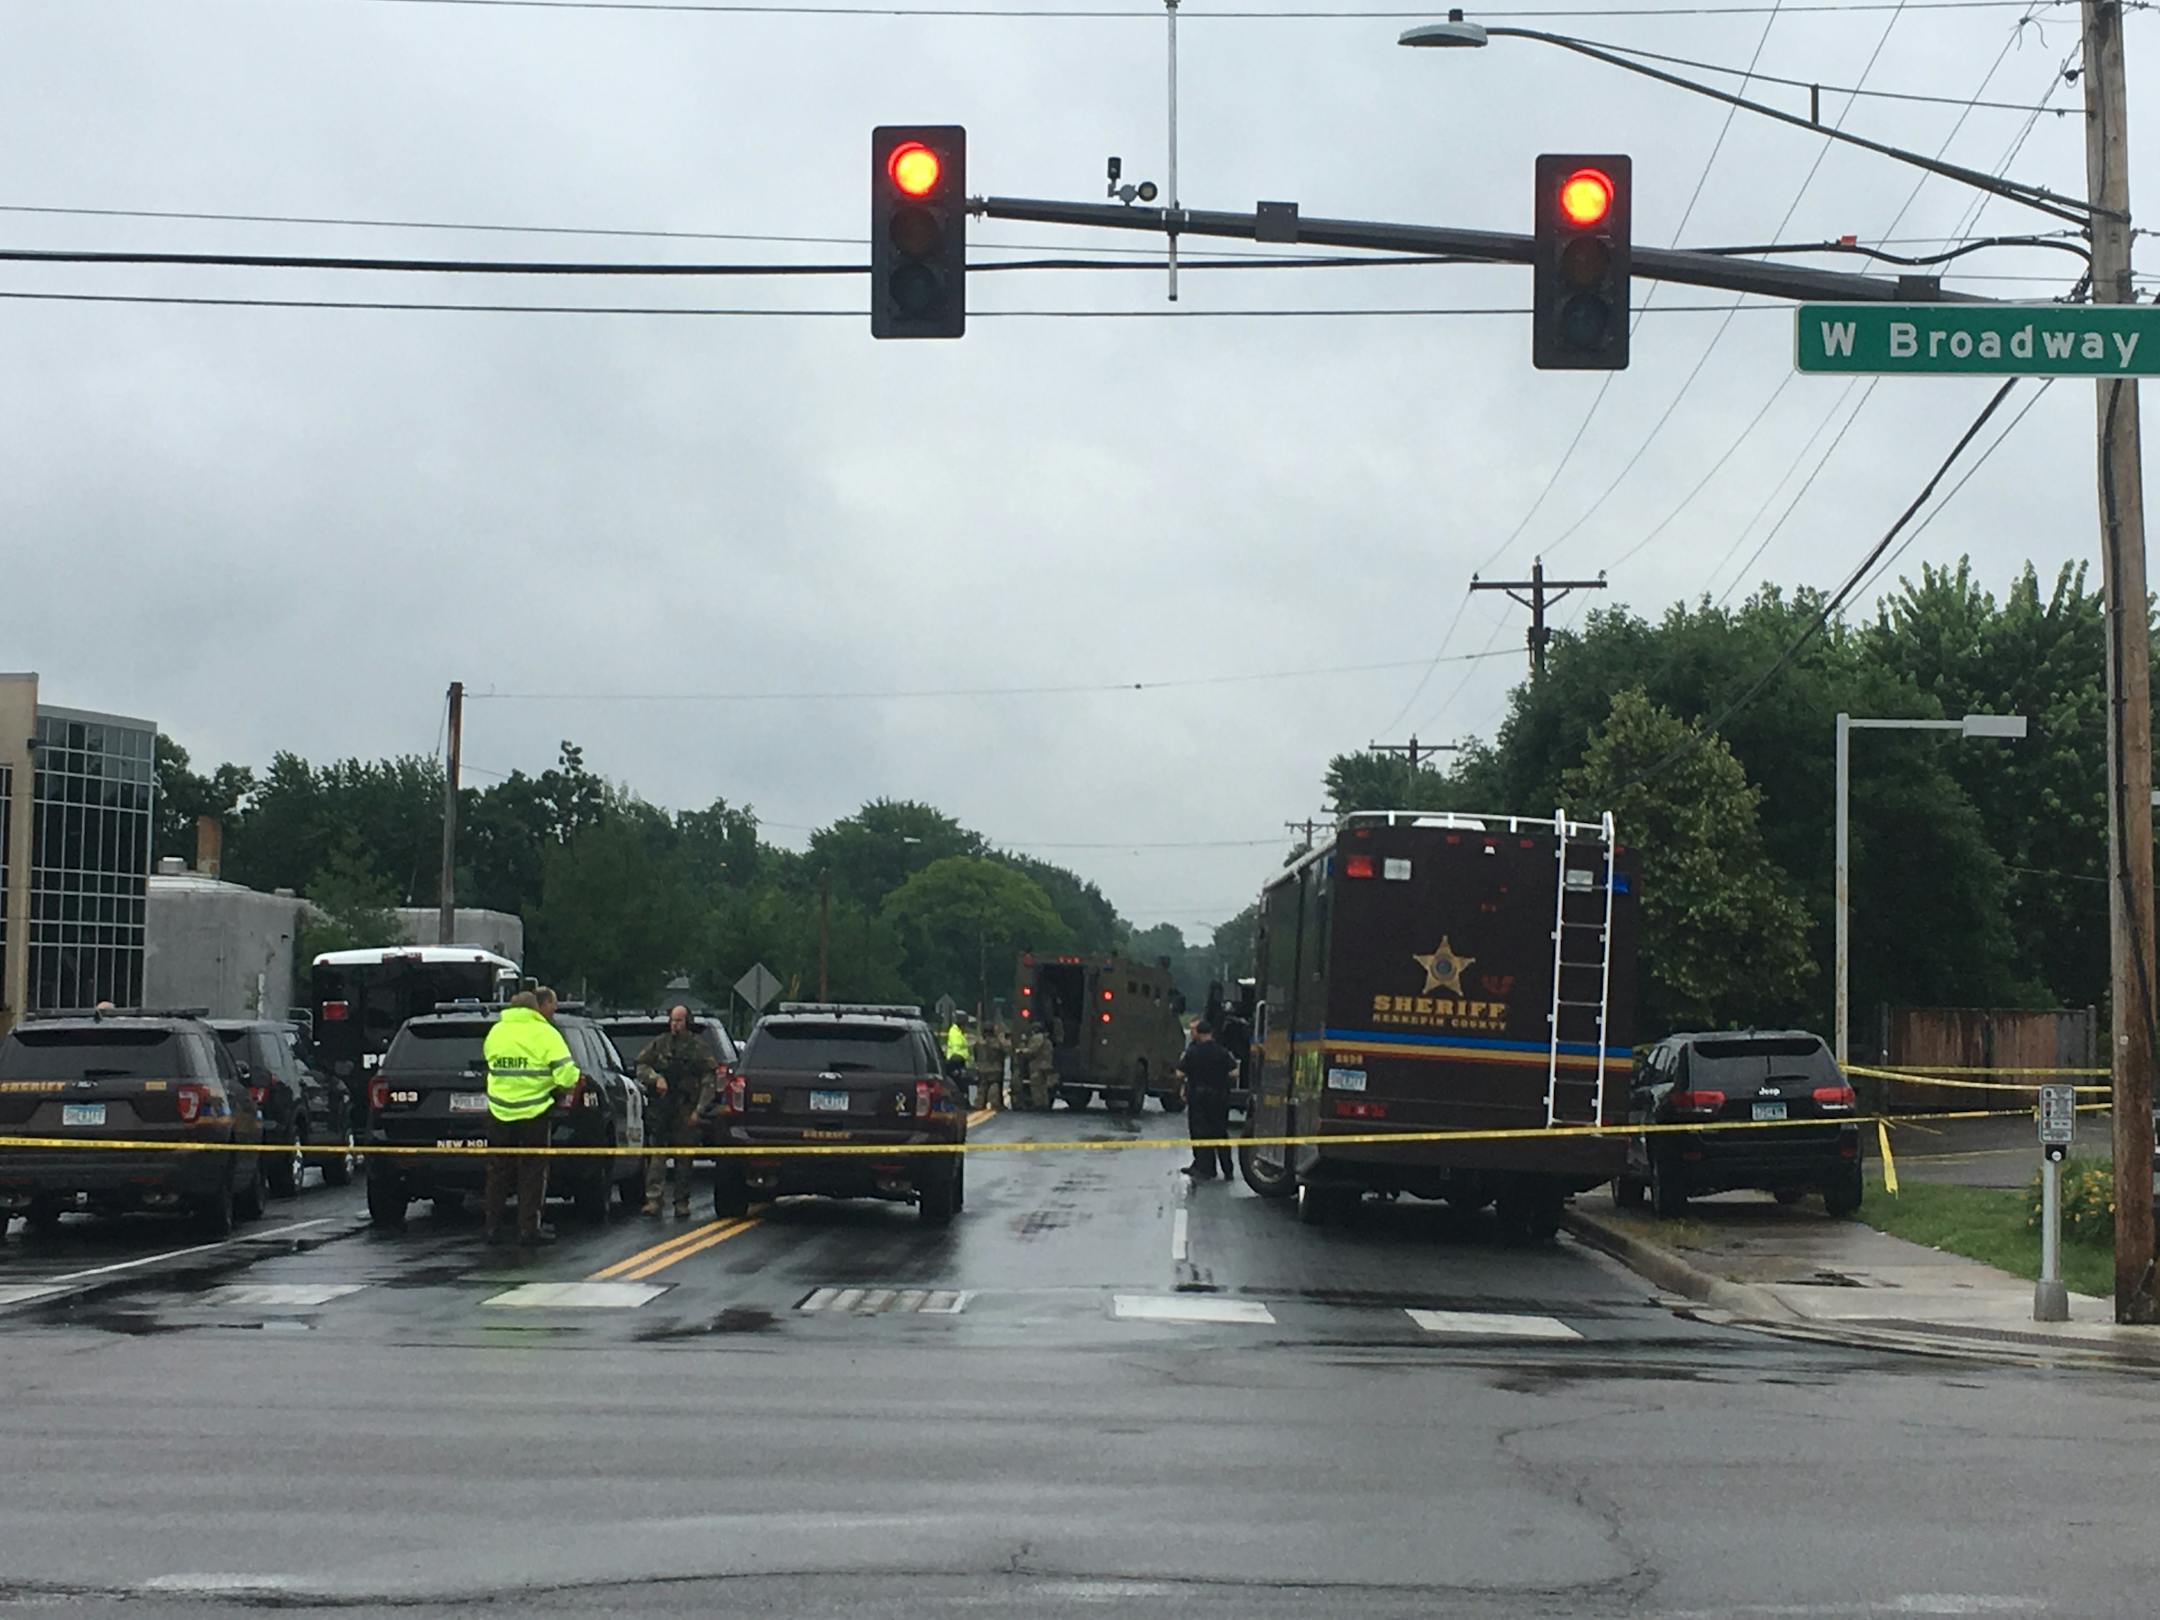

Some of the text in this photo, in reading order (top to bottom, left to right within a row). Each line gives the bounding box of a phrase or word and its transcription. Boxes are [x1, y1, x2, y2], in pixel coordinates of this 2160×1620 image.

[1820, 321, 2140, 368] W Broadway
[1374, 995, 1505, 1018] SHERIFF
[0, 1080, 66, 1093] SHERIFF
[1759, 1087, 1780, 1096] Jeep
[436, 1139, 464, 1149] NEW
